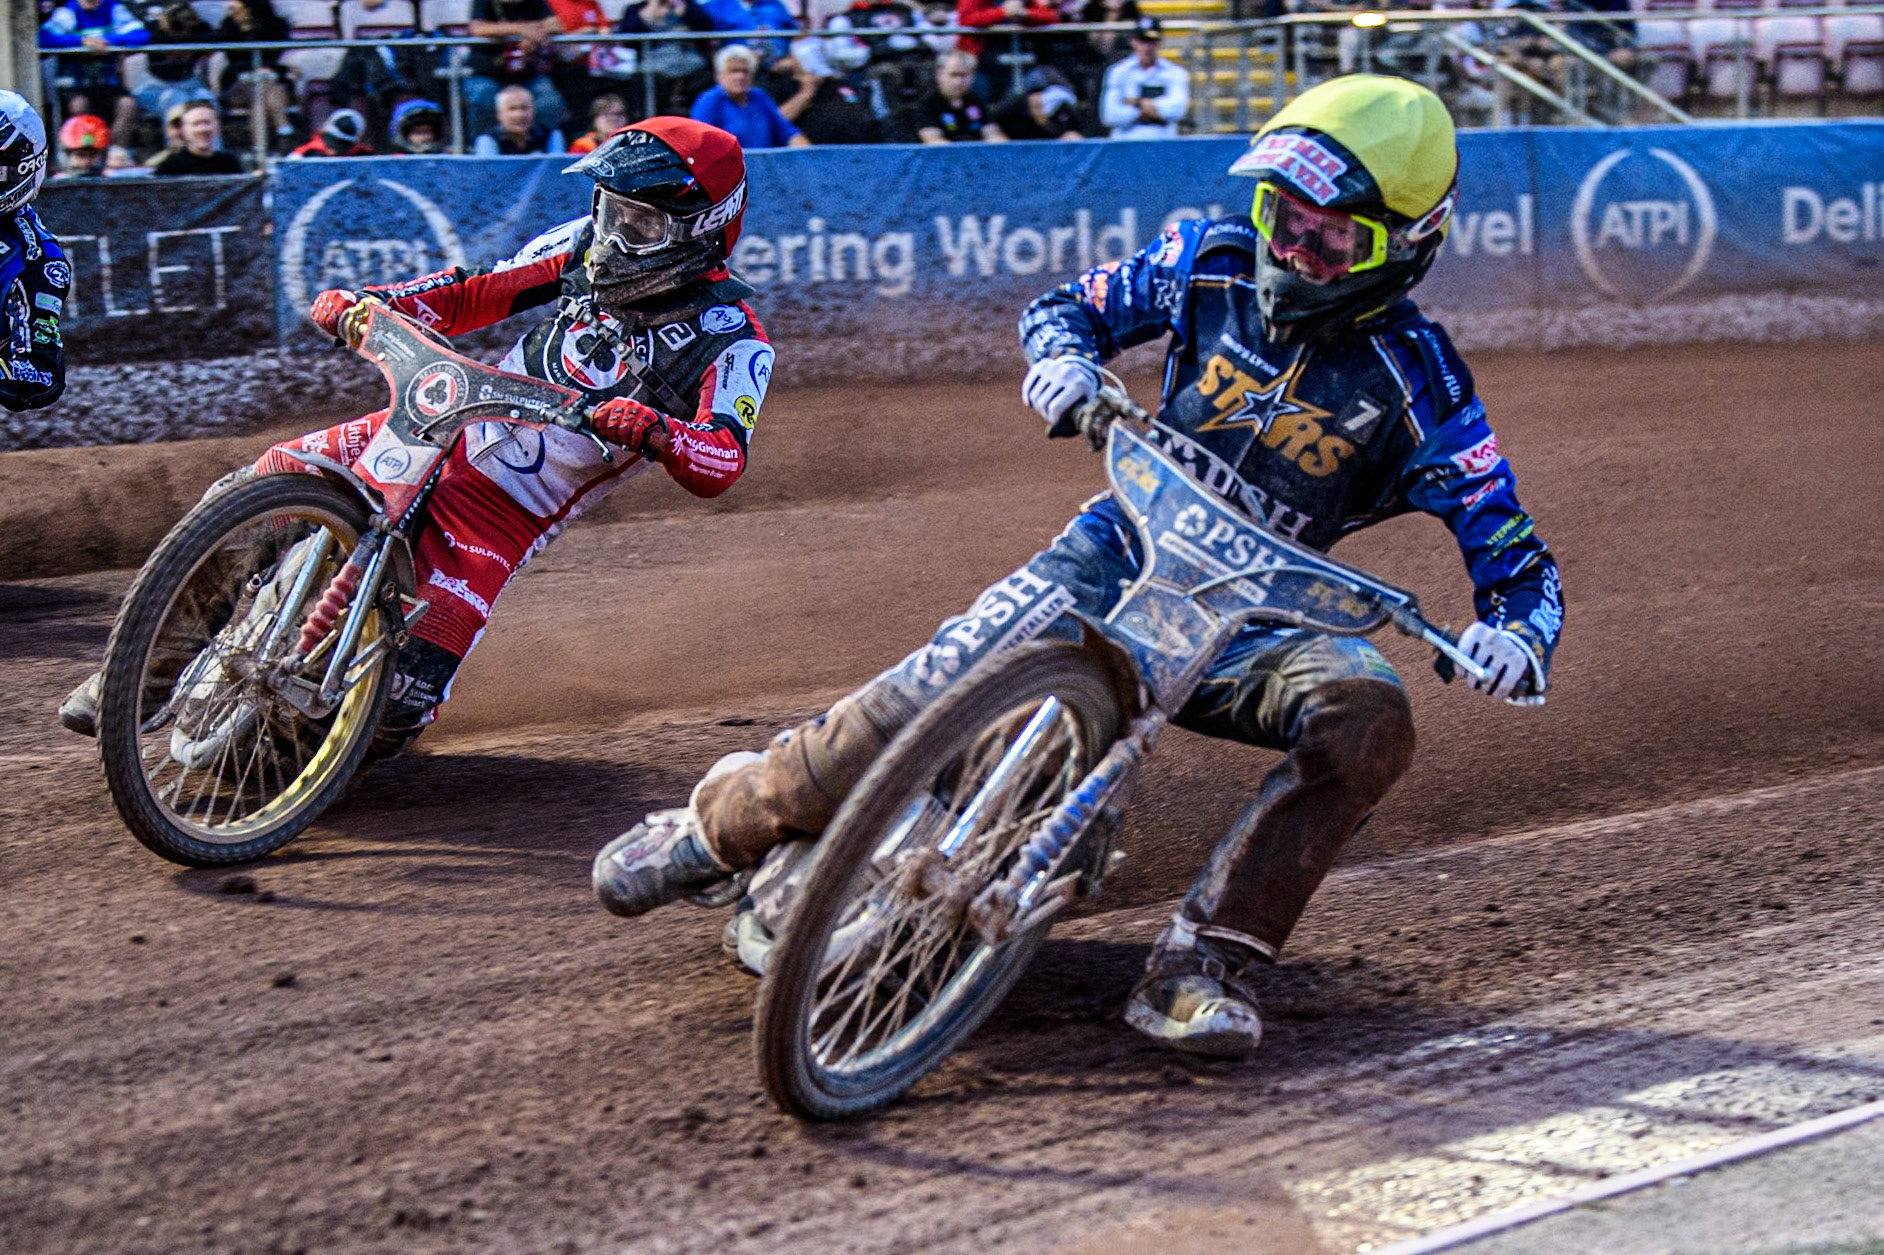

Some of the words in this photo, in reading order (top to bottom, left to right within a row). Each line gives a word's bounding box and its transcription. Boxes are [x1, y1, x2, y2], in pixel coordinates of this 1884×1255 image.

[733, 217, 914, 298] ering
[933, 207, 1138, 276] World
[1449, 194, 1534, 256] vel
[1598, 202, 1689, 248] ATPI
[1344, 400, 1382, 431] 7
[1201, 517, 1288, 586] PSH
[945, 565, 1053, 654] PSH
